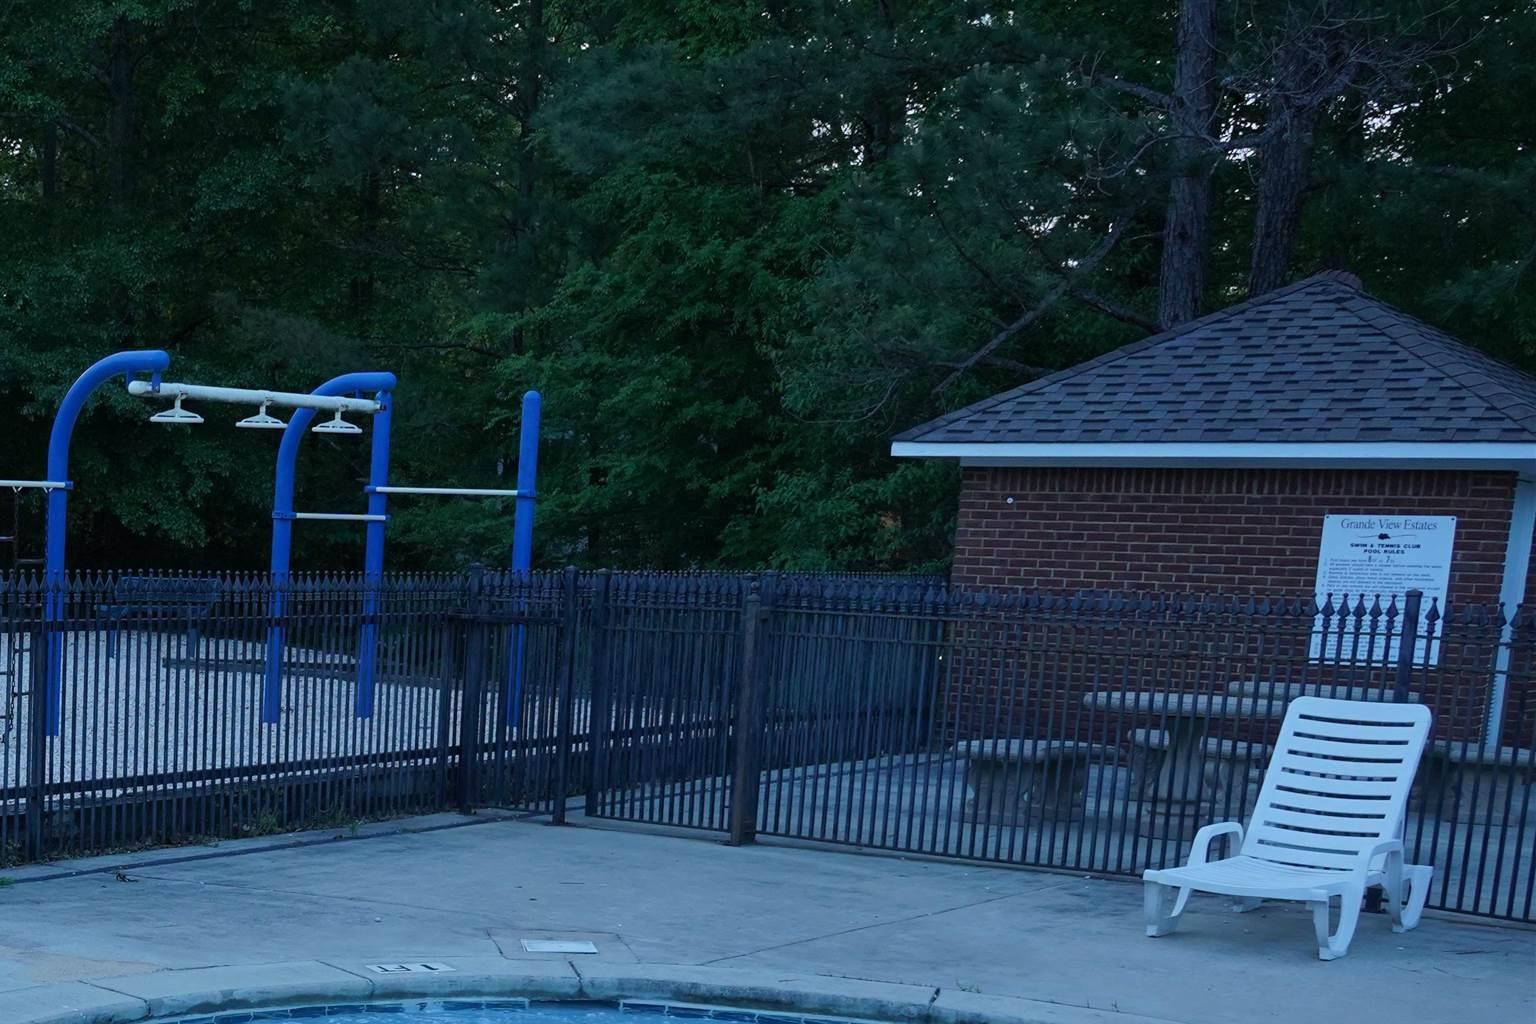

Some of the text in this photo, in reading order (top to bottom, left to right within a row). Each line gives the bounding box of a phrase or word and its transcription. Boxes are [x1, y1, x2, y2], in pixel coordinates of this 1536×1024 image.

[1340, 518, 1438, 531] Grande View Estates
